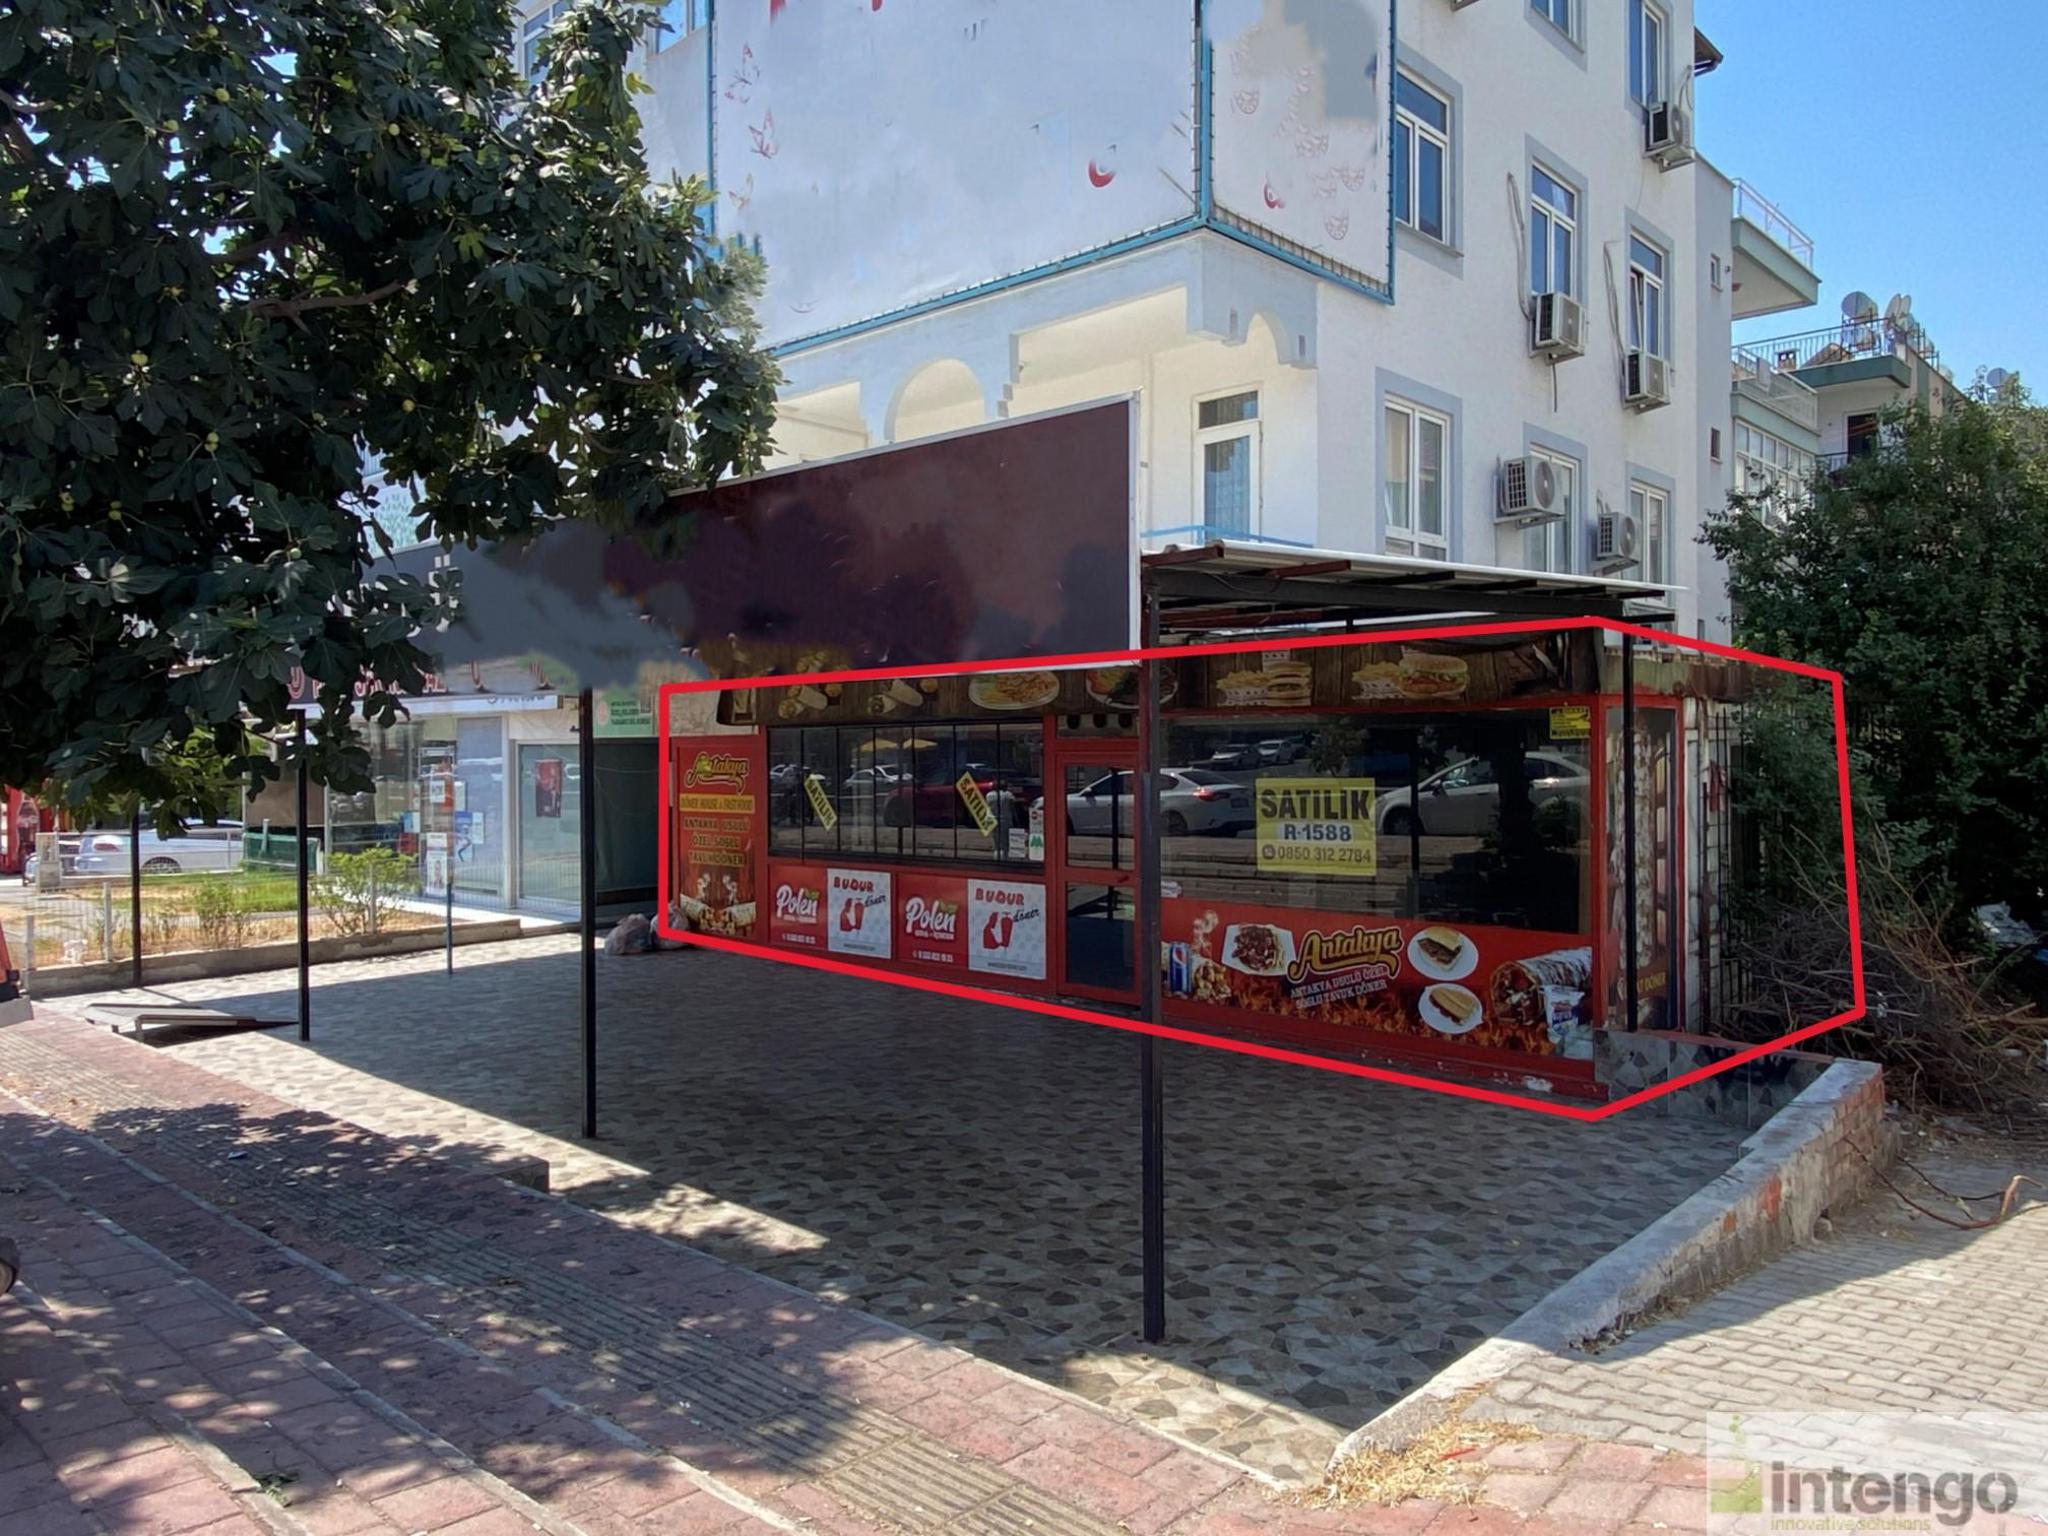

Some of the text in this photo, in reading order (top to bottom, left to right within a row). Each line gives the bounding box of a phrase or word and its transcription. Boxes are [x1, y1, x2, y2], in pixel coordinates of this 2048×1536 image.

[806, 779, 835, 827] SATILIK
[1261, 789, 1370, 819] SATILIK
[1278, 846, 1371, 863] 0850 312 2784
[776, 884, 819, 918] Polen
[905, 896, 957, 934] Polen
[1287, 925, 1403, 983] Antakya
[1290, 980, 1332, 998] ANTAKYA
